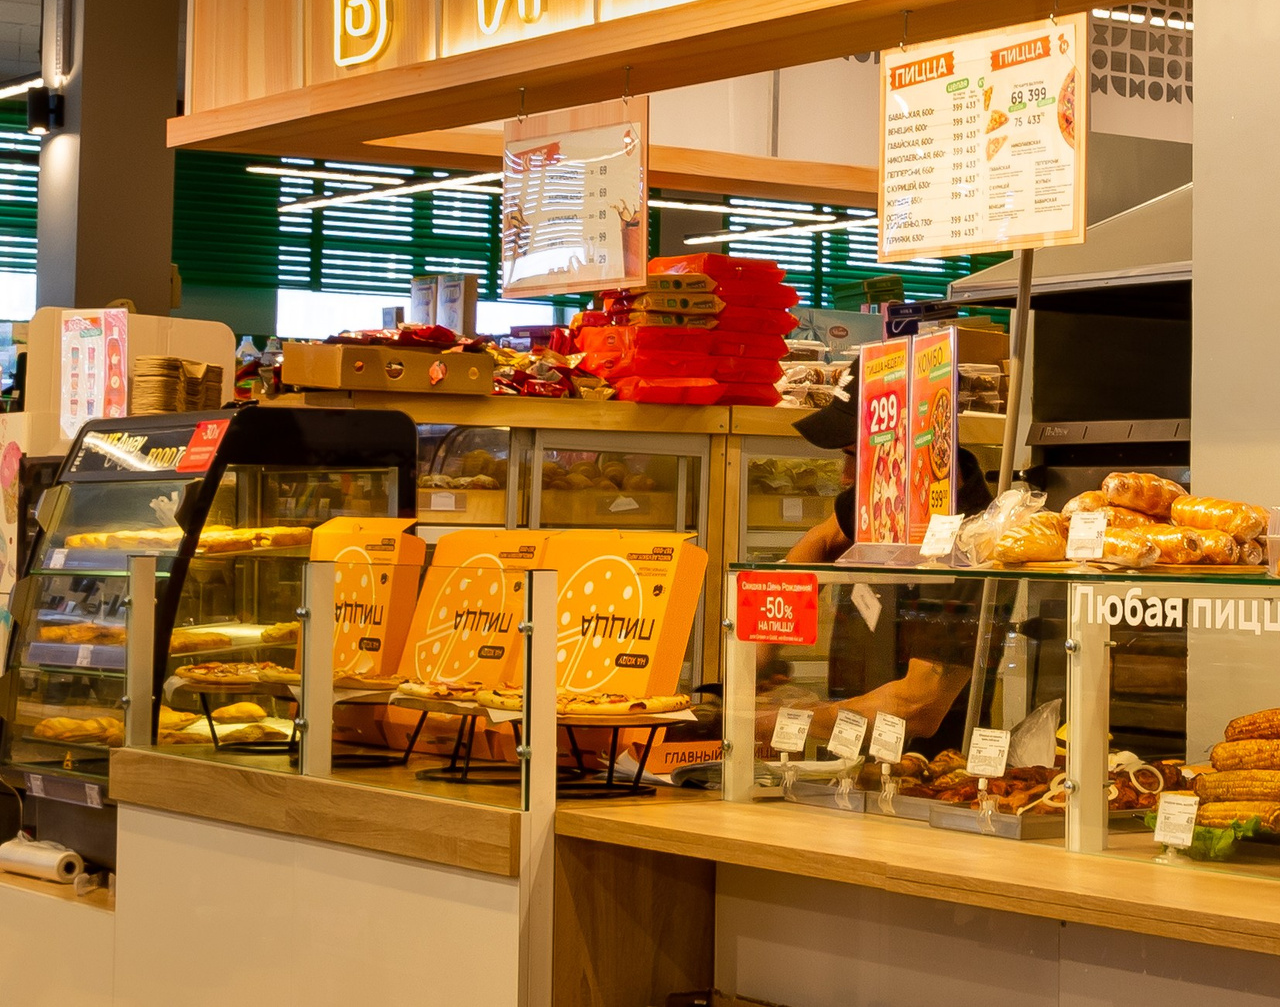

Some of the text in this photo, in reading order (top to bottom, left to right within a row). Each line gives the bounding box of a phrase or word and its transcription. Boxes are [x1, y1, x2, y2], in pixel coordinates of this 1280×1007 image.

[999, 41, 1044, 66] ПИЦЦА
[895, 57, 947, 87] ПИЦЦА
[1011, 91, 1023, 105] 69
[1028, 87, 1047, 102] 399
[1014, 115, 1041, 127] 75 433
[870, 394, 897, 433] 299
[335, 601, 384, 625] ПИЦЦА
[760, 596, 793, 619] -50%
[1072, 586, 1183, 629] Любая
[454, 608, 513, 633] ПИЦЦА
[581, 615, 656, 641] ПИЦЦА
[758, 621, 794, 633] НА ПИЦЦУ
[665, 747, 722, 764] ГЛАВНЫЙ
